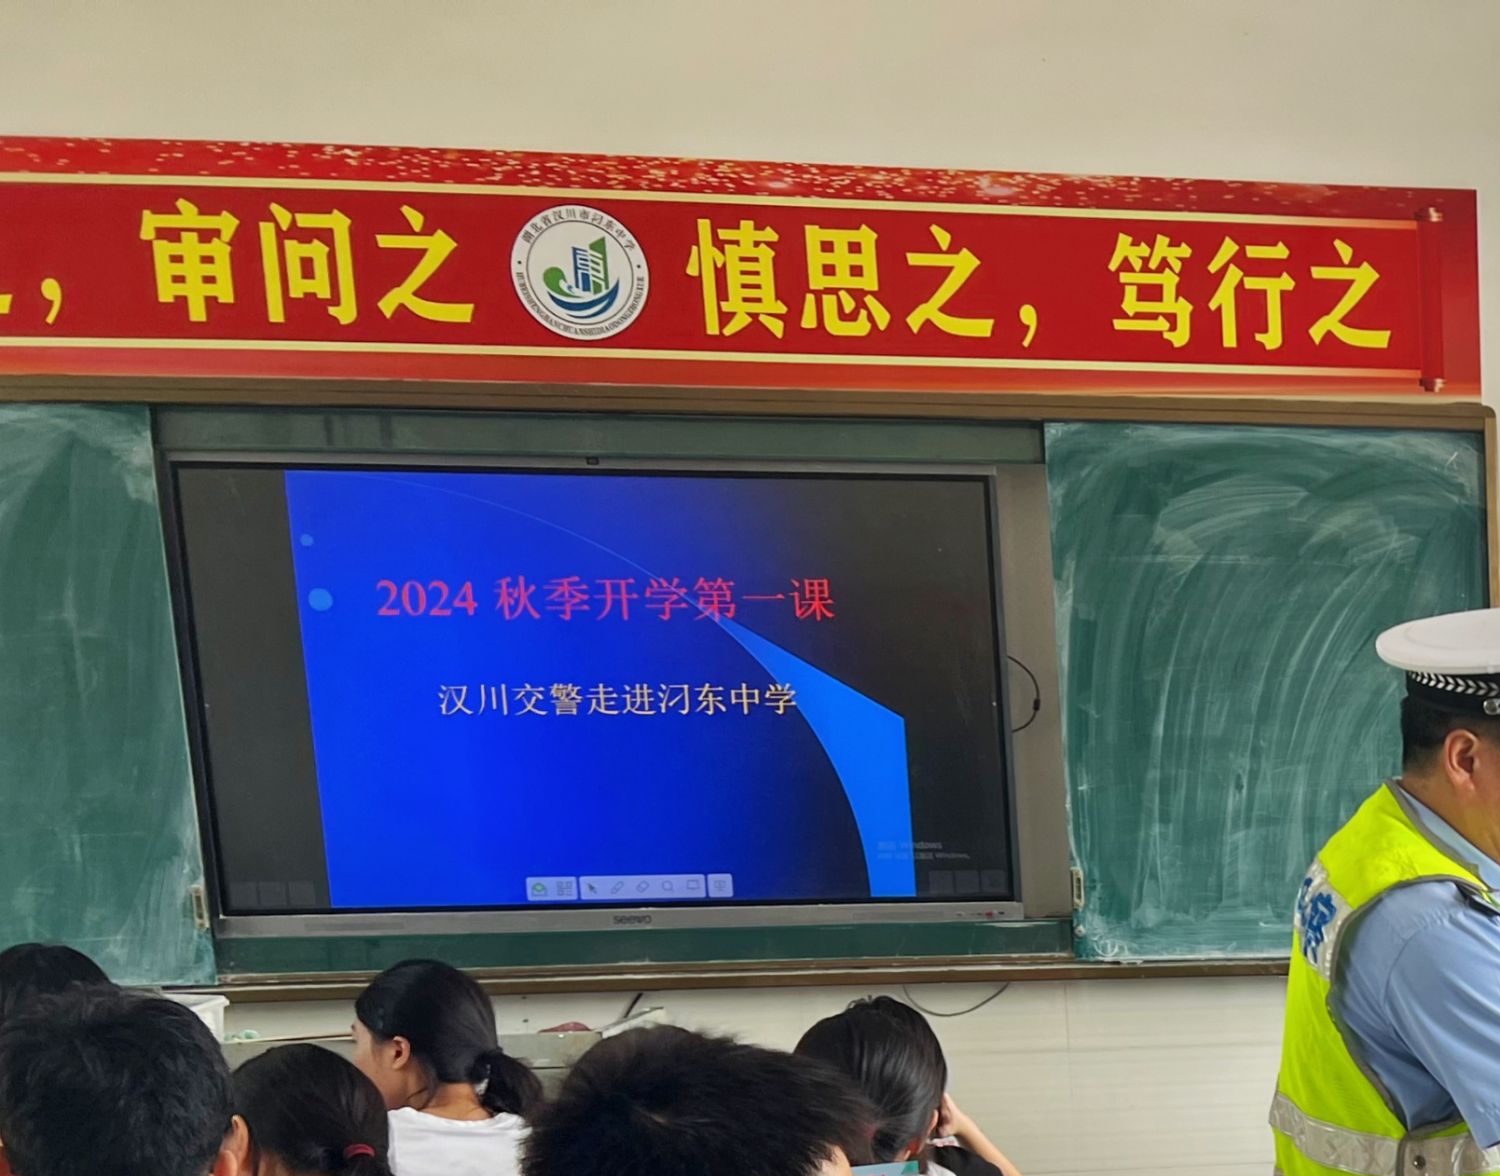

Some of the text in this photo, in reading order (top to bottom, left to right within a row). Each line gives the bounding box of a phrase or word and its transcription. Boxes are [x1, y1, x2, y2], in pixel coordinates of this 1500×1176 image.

[140, 198, 474, 324] 审问之
[686, 219, 1393, 350] 慎思之， 笃行之
[376, 575, 836, 623] 2024 秋季开学第一课
[437, 681, 798, 718] 汉川交警走进汈东中学
